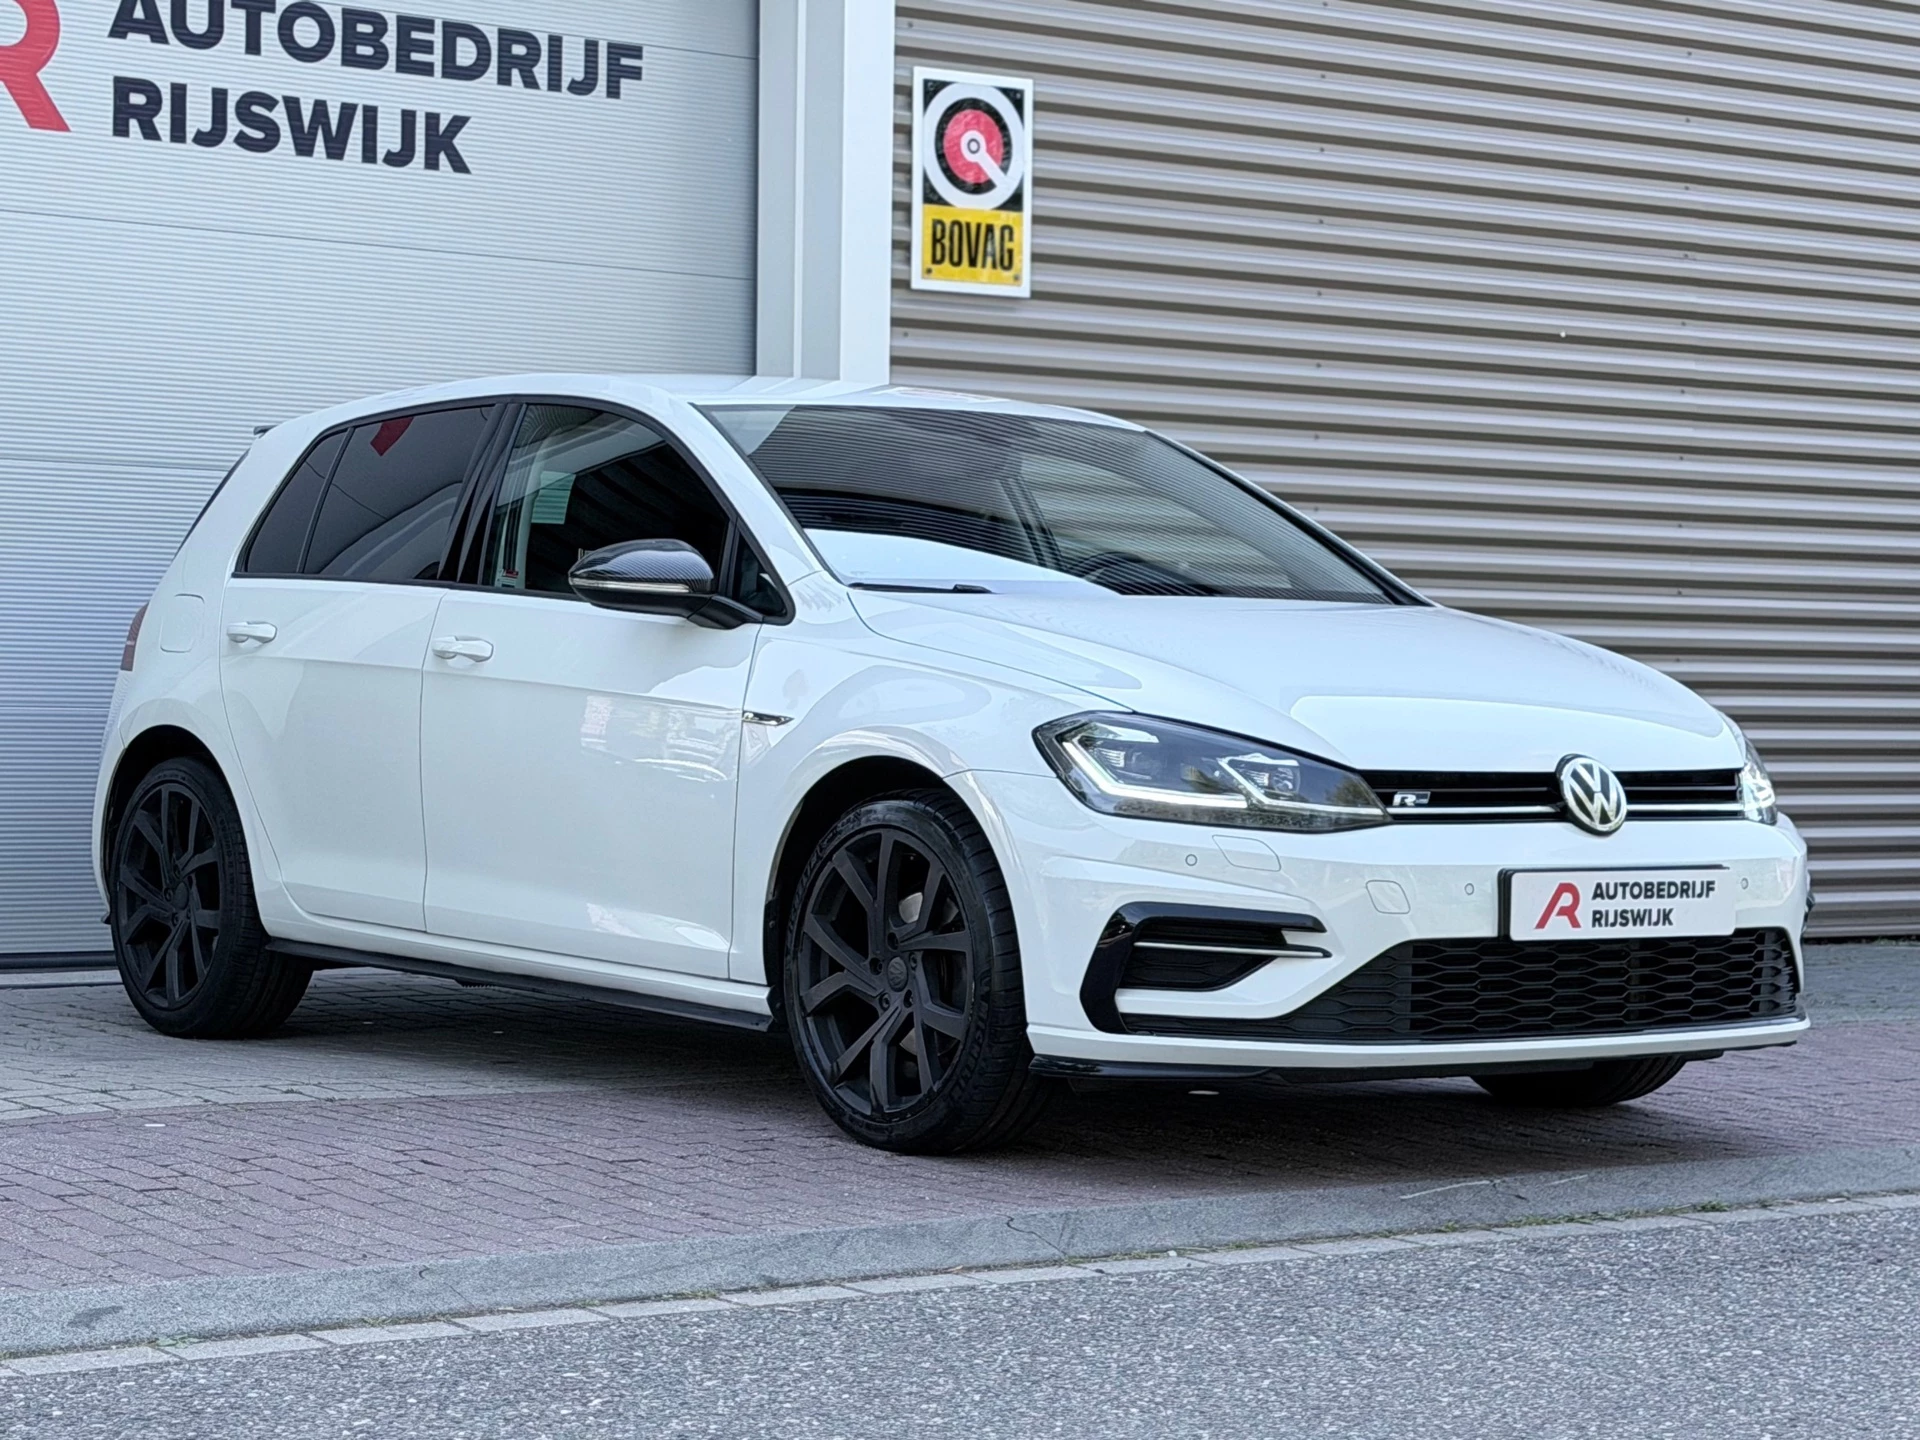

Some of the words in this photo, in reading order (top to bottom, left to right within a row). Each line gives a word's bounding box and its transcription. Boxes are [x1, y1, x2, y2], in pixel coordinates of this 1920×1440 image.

[108, 0, 643, 100] AUTOBEDRIJF
[112, 75, 472, 174] RIJSWIJK
[931, 218, 1014, 271] BOVAG
[1591, 880, 1716, 901] AUTOBEDRIJF
[1591, 908, 1674, 928] RIJSWIJK
